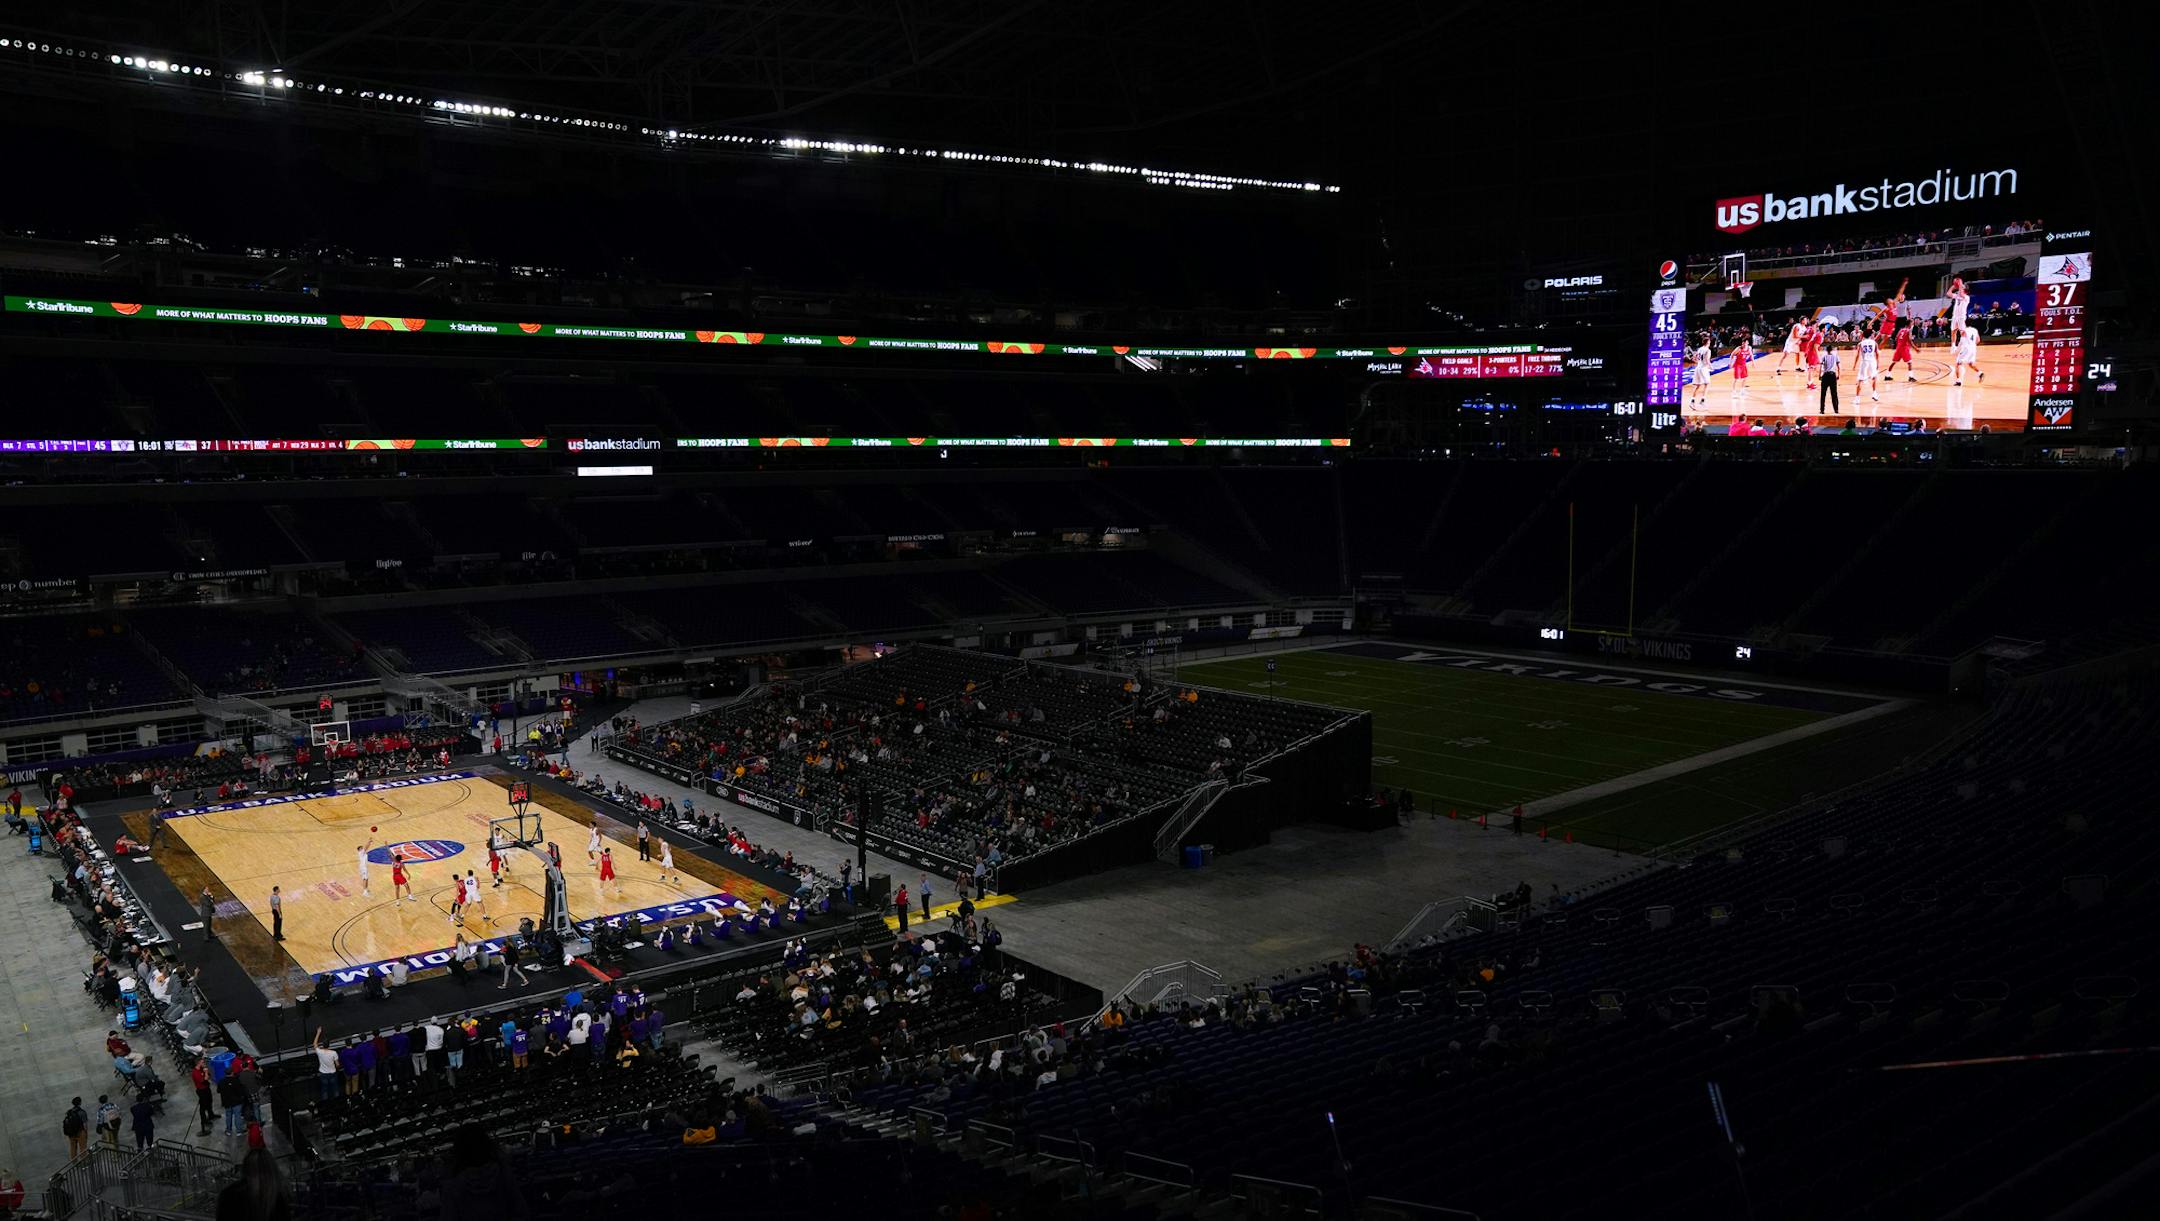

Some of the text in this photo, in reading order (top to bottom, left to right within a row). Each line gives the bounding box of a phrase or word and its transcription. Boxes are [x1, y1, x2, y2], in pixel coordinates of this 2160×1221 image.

[2056, 230, 2091, 241] PENTAIR
[1544, 275, 1602, 288] POLARIS
[2047, 283, 2078, 306] 37
[37, 301, 95, 314] StarTribune
[156, 309, 180, 318] MORE
[192, 311, 215, 319] WHAT
[217, 312, 251, 321] MATTERS
[264, 314, 299, 323] HOOPS
[301, 315, 327, 326] FANS
[1656, 313, 1677, 332] 45
[2047, 315, 2075, 325] 2 6
[636, 331, 663, 339] HOOPS
[664, 332, 686, 340] FANS
[937, 341, 960, 350] HOOPS
[961, 342, 979, 350] FANS
[1658, 339, 1678, 348] 3 5
[1863, 344, 1874, 354] 33
[2040, 347, 2075, 357] 2 2 1
[2037, 356, 2075, 367] 11 7 1
[1463, 366, 1478, 375] 29%
[1485, 367, 1497, 375] 0-3
[1549, 364, 1564, 374] 77%
[2036, 366, 2075, 375] 23 3 0
[2087, 363, 2112, 380] 24
[2035, 374, 2074, 384] 24 10 1
[2034, 383, 2074, 393] 25 8 2
[2034, 397, 2074, 407] Andersen
[1613, 402, 1643, 415] 16:01
[1651, 412, 1677, 430] Lite
[17, 441, 22, 449] 7
[94, 440, 107, 450] 45
[138, 440, 161, 450] 16:01
[201, 440, 212, 450] 37
[283, 441, 288, 449] 7
[300, 441, 309, 449] 29
[321, 441, 326, 449] 3
[699, 438, 726, 447] HOOPS
[727, 438, 750, 447] FANS
[34, 577, 79, 589] number
[1642, 639, 1692, 661] VIKINGS
[1736, 646, 1751, 659] 24
[1396, 651, 1766, 700] VIKINGS
[8, 767, 48, 784] VIKIN
[176, 773, 463, 816] U.S. BANK STADIUM
